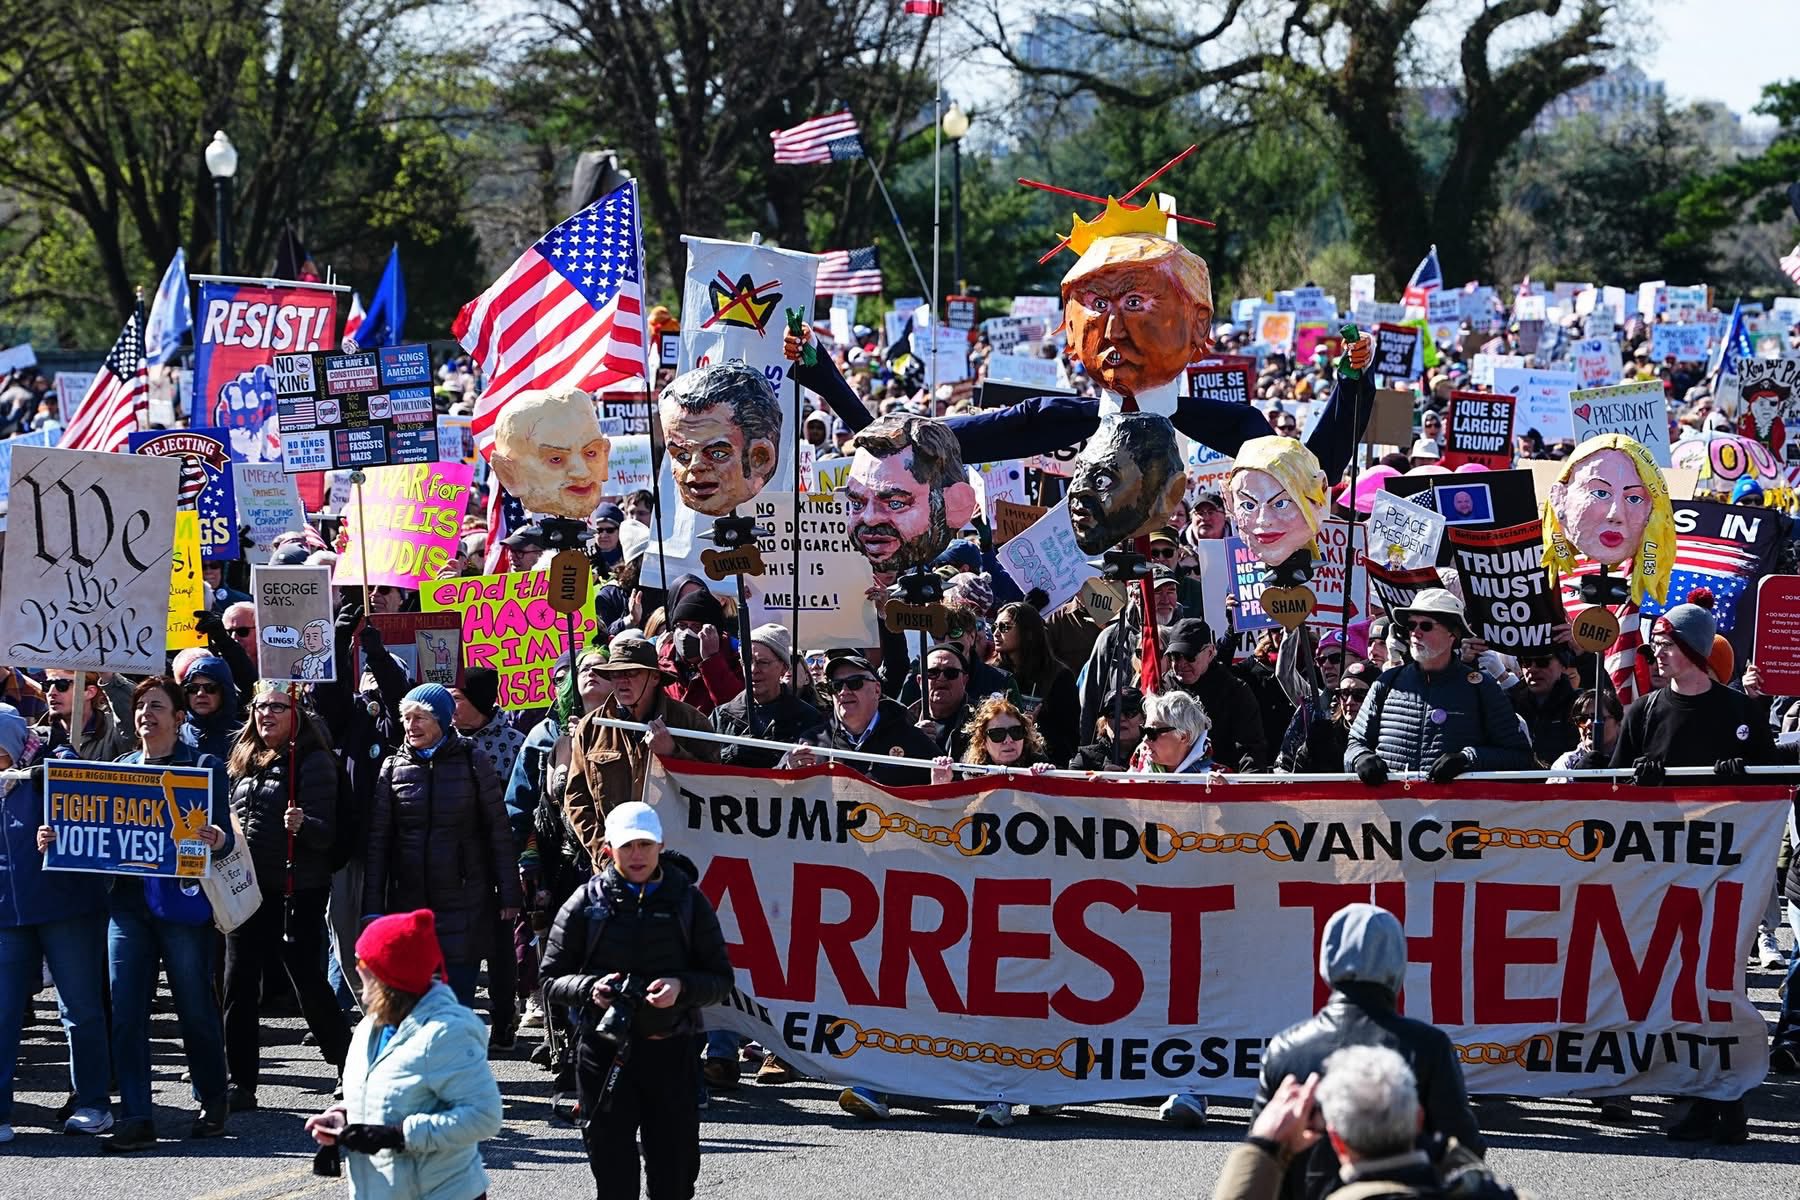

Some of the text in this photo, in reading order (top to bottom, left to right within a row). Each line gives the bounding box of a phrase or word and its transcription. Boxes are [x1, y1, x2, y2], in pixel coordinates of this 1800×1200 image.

[201, 299, 328, 352] RESIST!
[275, 356, 295, 374] NO
[333, 358, 370, 368] WE HAVE A
[398, 352, 424, 361] KINGS
[329, 367, 375, 379] CONSTITUTION
[386, 365, 425, 377] AMERICA
[1227, 372, 1244, 386] SE
[277, 375, 310, 393] KING
[333, 379, 347, 390] NOT
[350, 380, 355, 388] A
[1455, 400, 1510, 418] ¡QUE SE
[1592, 401, 1657, 426] PRESIDENT
[1453, 417, 1509, 434] LARGUE
[144, 435, 215, 456] REJECTING
[288, 438, 325, 449] NO KINGS
[348, 431, 371, 442] KINGS
[1454, 432, 1505, 452] TRUMP
[350, 440, 384, 452] FASCISTS
[290, 455, 325, 465] AMERICA
[350, 451, 372, 462] NAZIS
[242, 469, 289, 484] IMPEACH
[377, 463, 429, 502] WAR
[12, 456, 160, 577] We
[248, 509, 271, 517] UNFIT
[756, 502, 851, 516] NO KINGS!
[255, 516, 288, 525] CORRUPT
[1385, 506, 1429, 537] PEACE
[1720, 513, 1762, 544] IN
[757, 539, 776, 551] NO
[1315, 528, 1347, 546] NO
[1372, 519, 1432, 557] PRESIDENT
[1552, 532, 1569, 559] LIES
[712, 554, 751, 574] LICKER
[1643, 541, 1659, 576] LIES
[810, 562, 825, 576] IS
[262, 582, 319, 595] GEORGE
[433, 570, 549, 604] end th
[561, 564, 578, 601] ADOLF
[1238, 575, 1256, 585] NO
[1310, 580, 1343, 593] TIM
[1470, 571, 1546, 600] MUST
[64, 565, 119, 616] the
[763, 592, 839, 607] AMERICA!
[1091, 592, 1113, 611] TOOL
[1271, 600, 1307, 614] SHAM
[462, 599, 595, 643] HAOS,
[896, 612, 933, 629] POSER
[1491, 601, 1531, 623] GO
[9, 598, 153, 667] People
[275, 625, 288, 633] NO
[1483, 622, 1552, 648] NOW!
[1578, 621, 1613, 643] BARF
[268, 636, 295, 644] KINGS!
[466, 632, 585, 669] RIME
[50, 769, 161, 785] MAGA is RIGGING ELECTIONS
[51, 792, 166, 828] FIGHT BACK
[679, 786, 1742, 866] TRUMP BONDI VANCE PATEL
[54, 825, 165, 862] VOTE YES!
[698, 855, 1744, 1025] ARREST THEM!
[1526, 1031, 1739, 1074] LEAVITT
[607, 1066, 622, 1092] SONY
